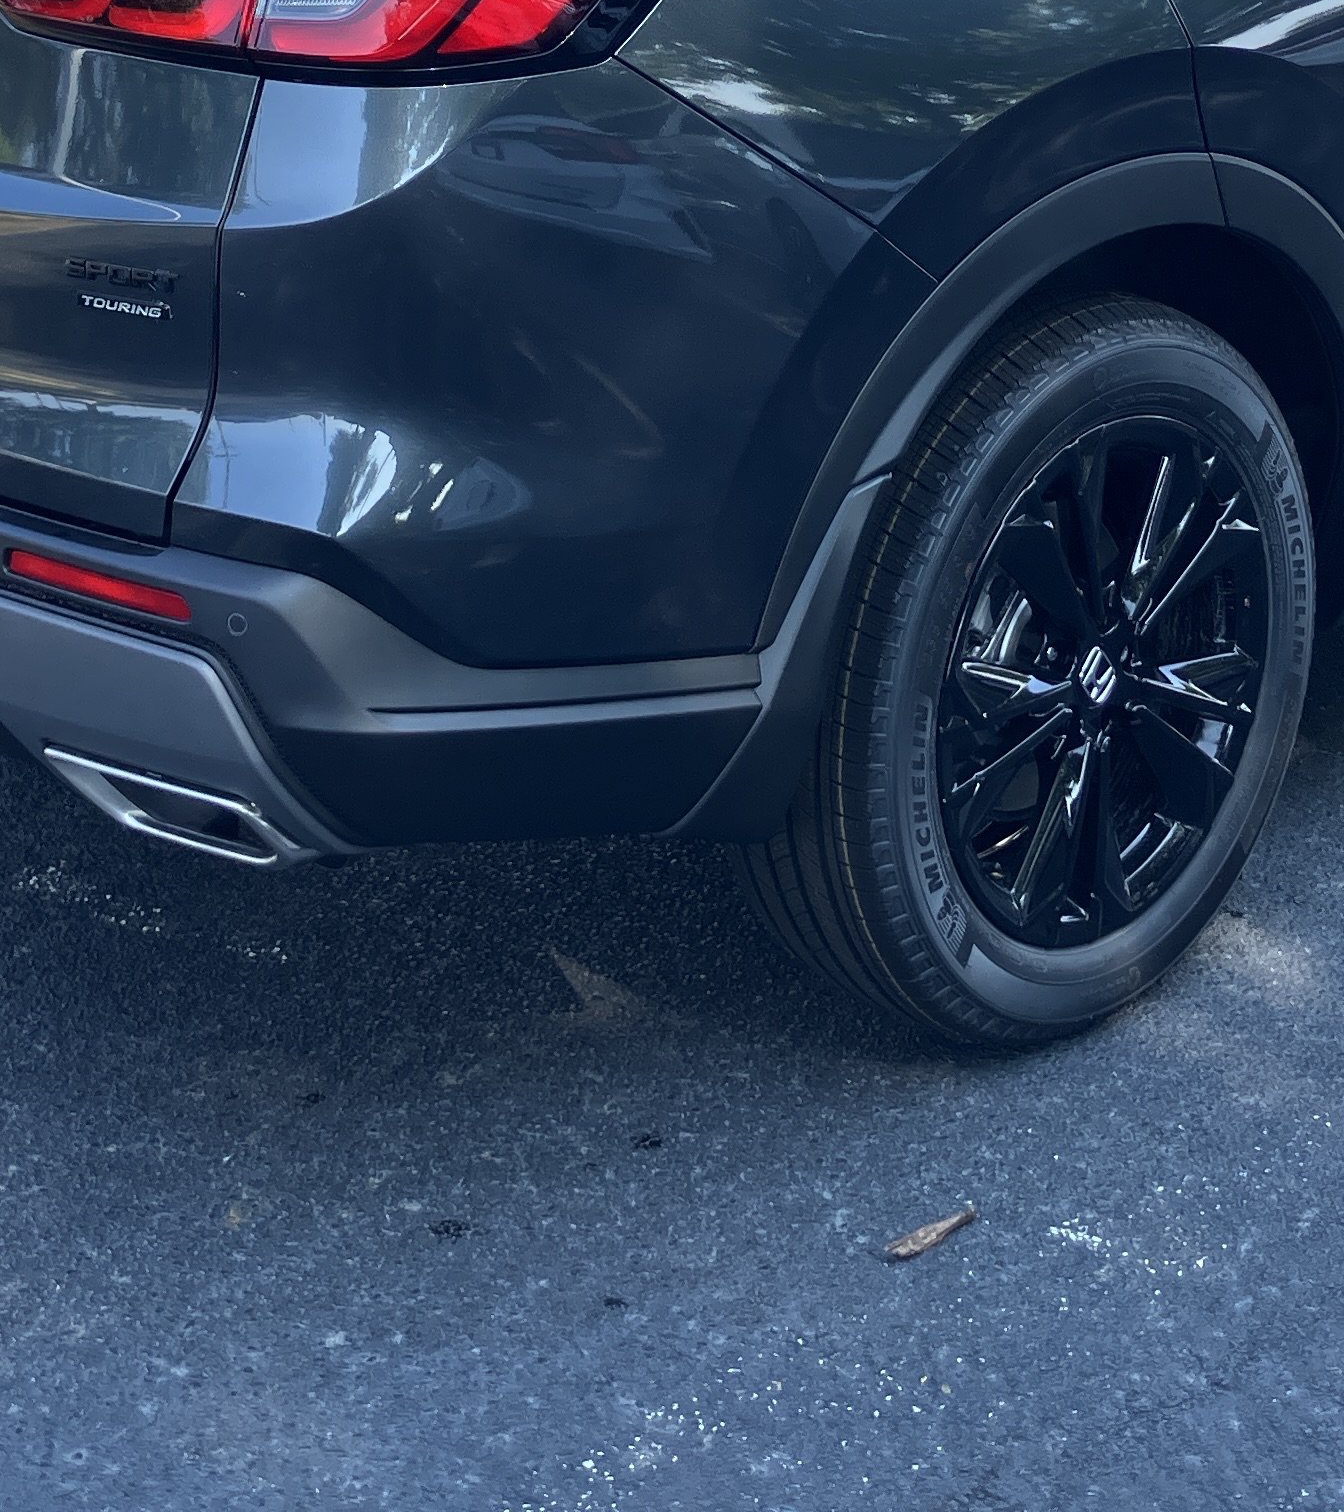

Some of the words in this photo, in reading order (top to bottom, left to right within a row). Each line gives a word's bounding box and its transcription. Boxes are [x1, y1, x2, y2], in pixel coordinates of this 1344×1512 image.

[64, 256, 180, 293] SPORT
[81, 294, 162, 319] TOURING
[1280, 494, 1307, 666] MICHELIN
[912, 701, 944, 895] MICHELIN
